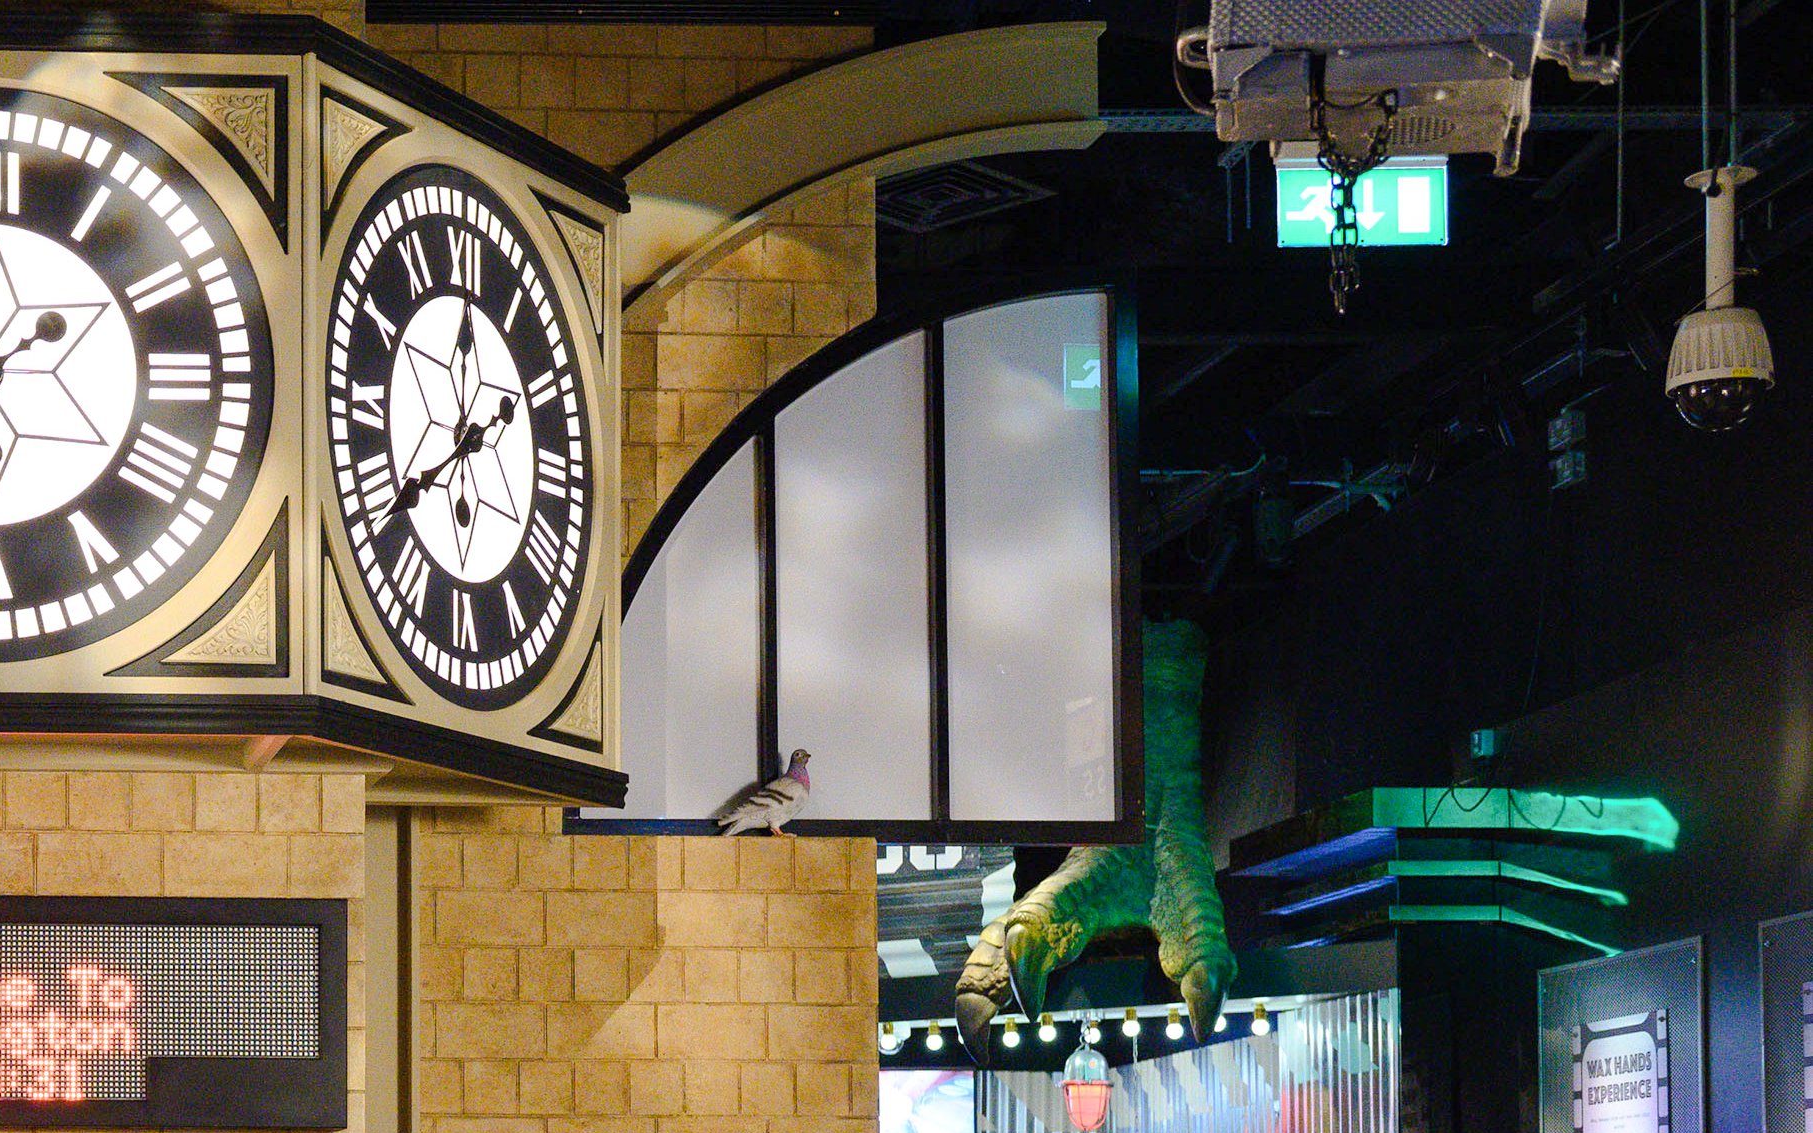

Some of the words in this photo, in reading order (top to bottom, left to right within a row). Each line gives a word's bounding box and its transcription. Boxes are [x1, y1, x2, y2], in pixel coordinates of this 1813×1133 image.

[125, 262, 191, 313] II
[397, 231, 433, 300] XI
[447, 226, 481, 297] XII
[363, 293, 397, 350] X
[528, 370, 557, 408] II
[67, 510, 120, 574] V
[502, 580, 526, 638] V
[71, 966, 133, 1007] To
[1587, 1057, 1612, 1079] WAX
[1614, 1051, 1652, 1075] HANDS
[1587, 1079, 1652, 1106] EXPERIENCE
